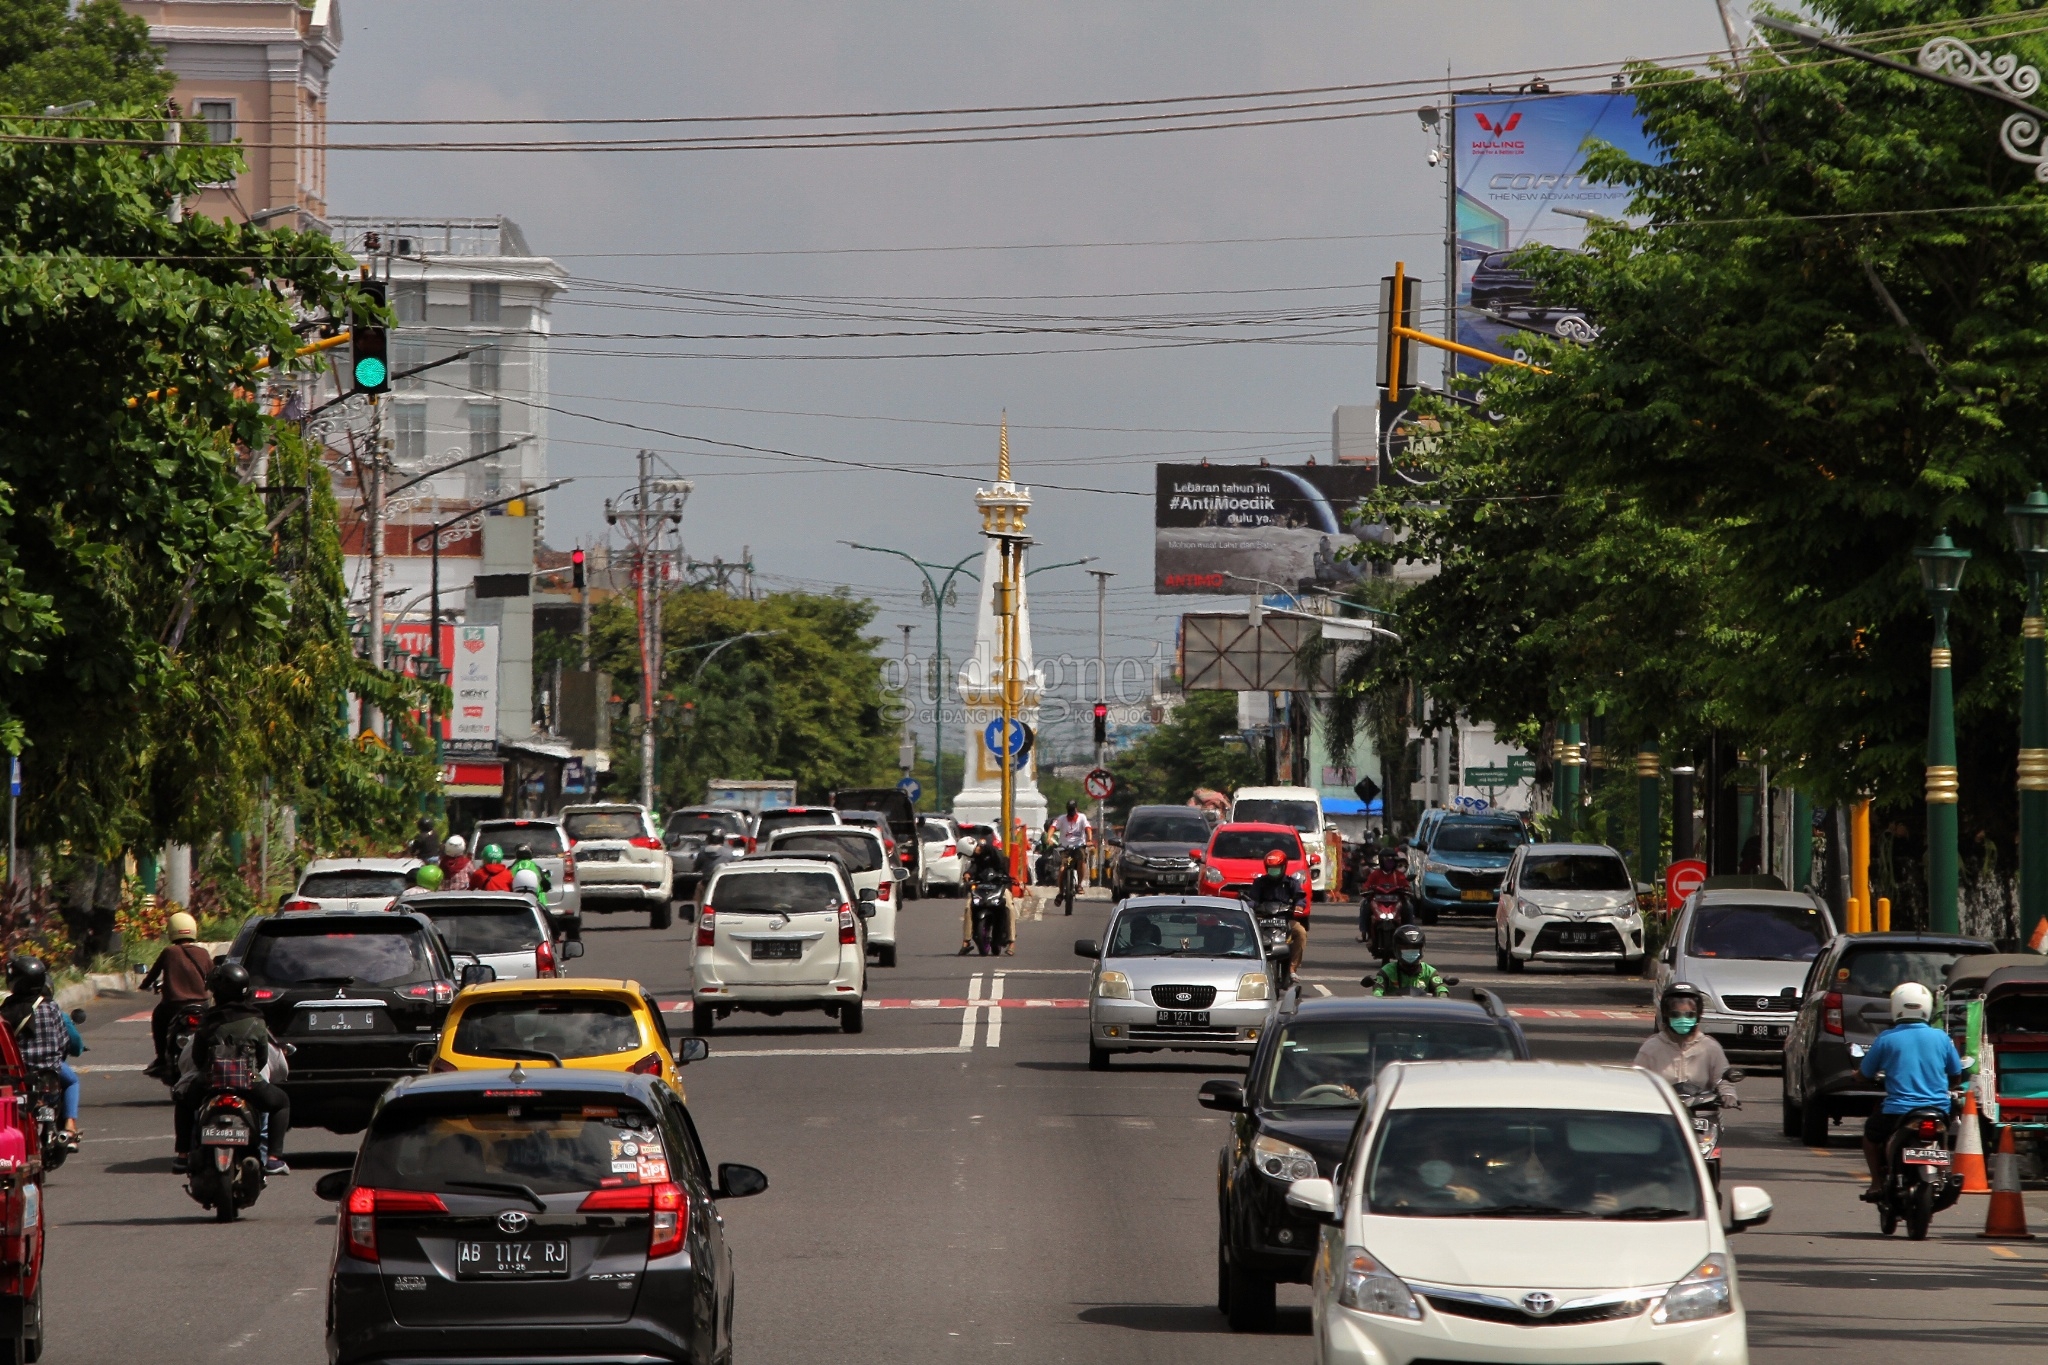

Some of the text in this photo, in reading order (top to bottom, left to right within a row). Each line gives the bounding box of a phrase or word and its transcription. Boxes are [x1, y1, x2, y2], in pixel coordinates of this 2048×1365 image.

[1174, 482, 1270, 493] Lebaran tahun ini
[1169, 496, 1275, 510] #AntiMoedik
[1227, 513, 1253, 523] dulu
[1165, 573, 1223, 587] ANTIMO
[310, 1012, 372, 1026] B 1 G
[1158, 1011, 1208, 1022] AB 1271 CK
[1738, 1024, 1744, 1035] D
[461, 1243, 565, 1262] AB 1174 RJ
